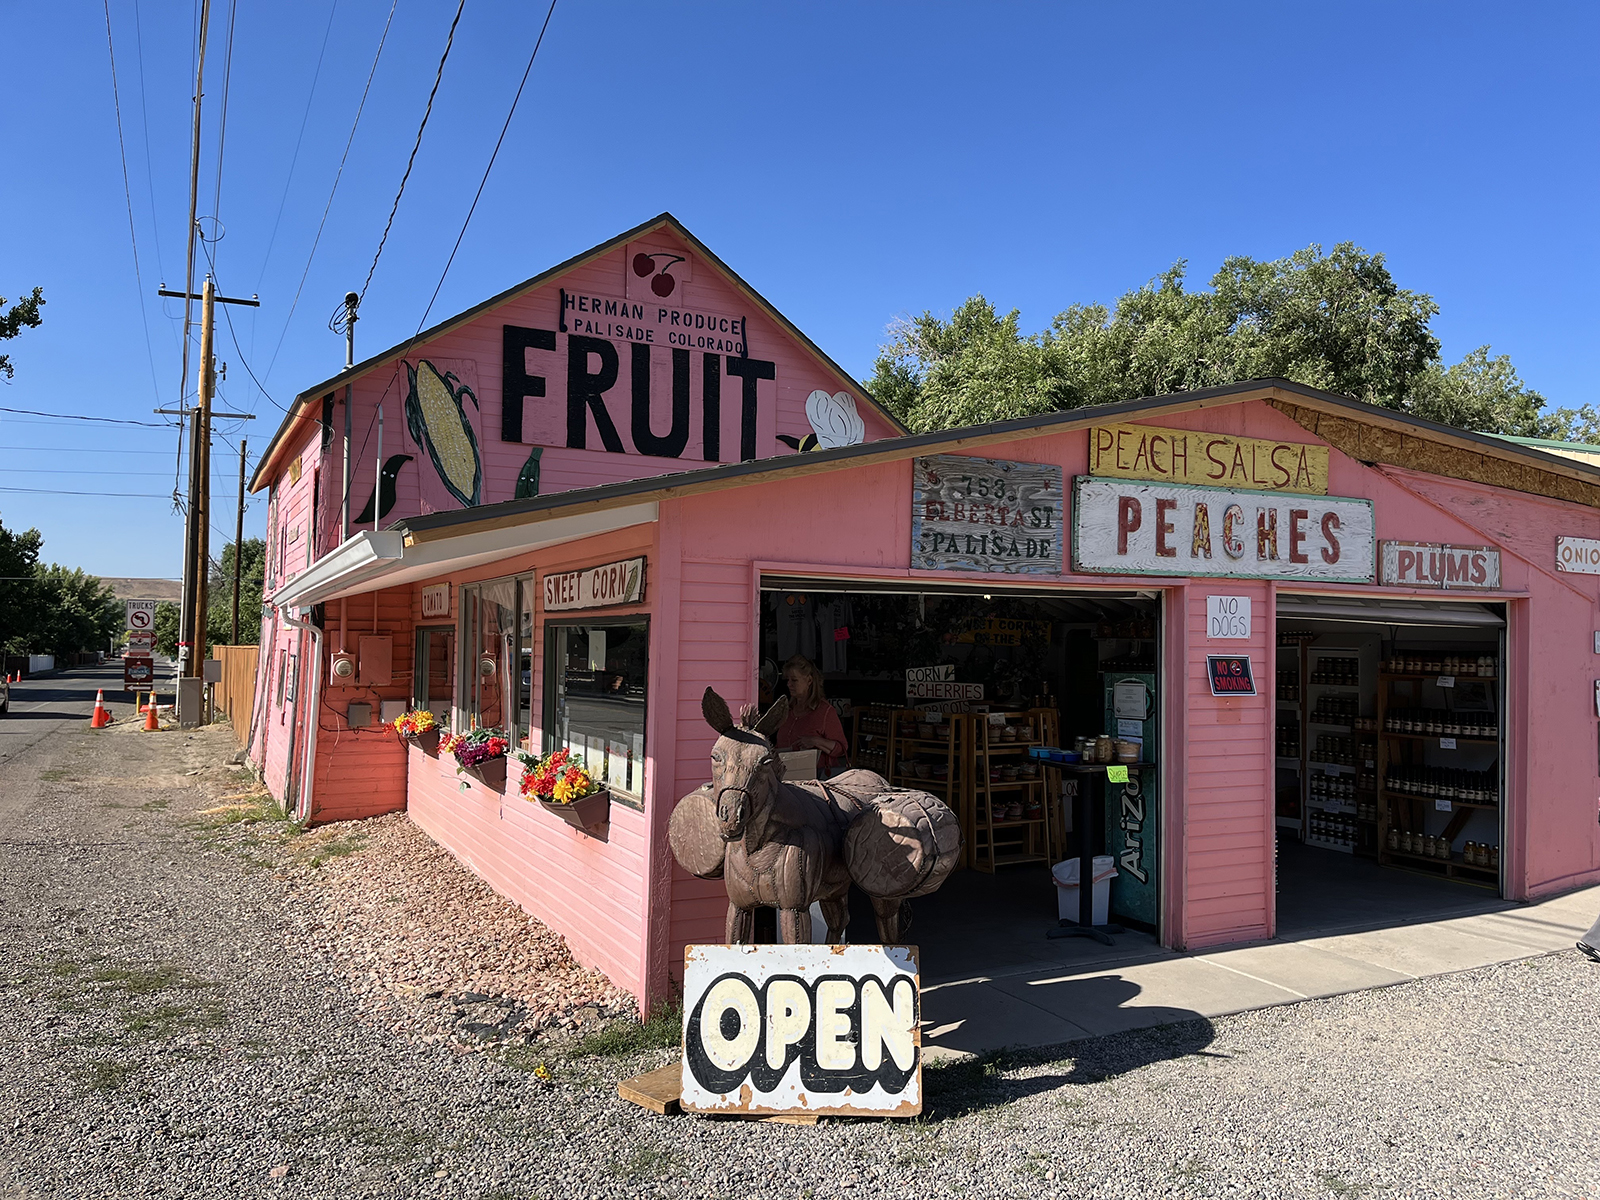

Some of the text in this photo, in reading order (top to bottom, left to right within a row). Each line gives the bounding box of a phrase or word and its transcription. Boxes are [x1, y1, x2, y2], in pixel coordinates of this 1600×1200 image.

[565, 293, 741, 335] HERMAN PRODUCE
[574, 318, 743, 354] PALISADE COLORADO
[501, 324, 776, 463] FRUIT
[1096, 428, 1313, 488] PEACH SALSA
[961, 476, 1006, 499] 753
[925, 500, 1054, 529] ELBERTA ST
[1117, 495, 1342, 565] PEACHES
[931, 532, 1051, 559] PALISADE
[1398, 550, 1487, 584] PLUMS
[547, 563, 627, 605] SWEET CORN
[129, 602, 153, 610] TRUCKS
[424, 592, 442, 611] TOMATO
[1219, 597, 1238, 615] NO
[1212, 615, 1247, 636] DOGS
[907, 667, 941, 682] CORN
[1216, 661, 1228, 675] NO
[916, 683, 982, 700] CHERRIES
[1215, 677, 1252, 691] SMOKING
[688, 972, 916, 1086] OPEN
